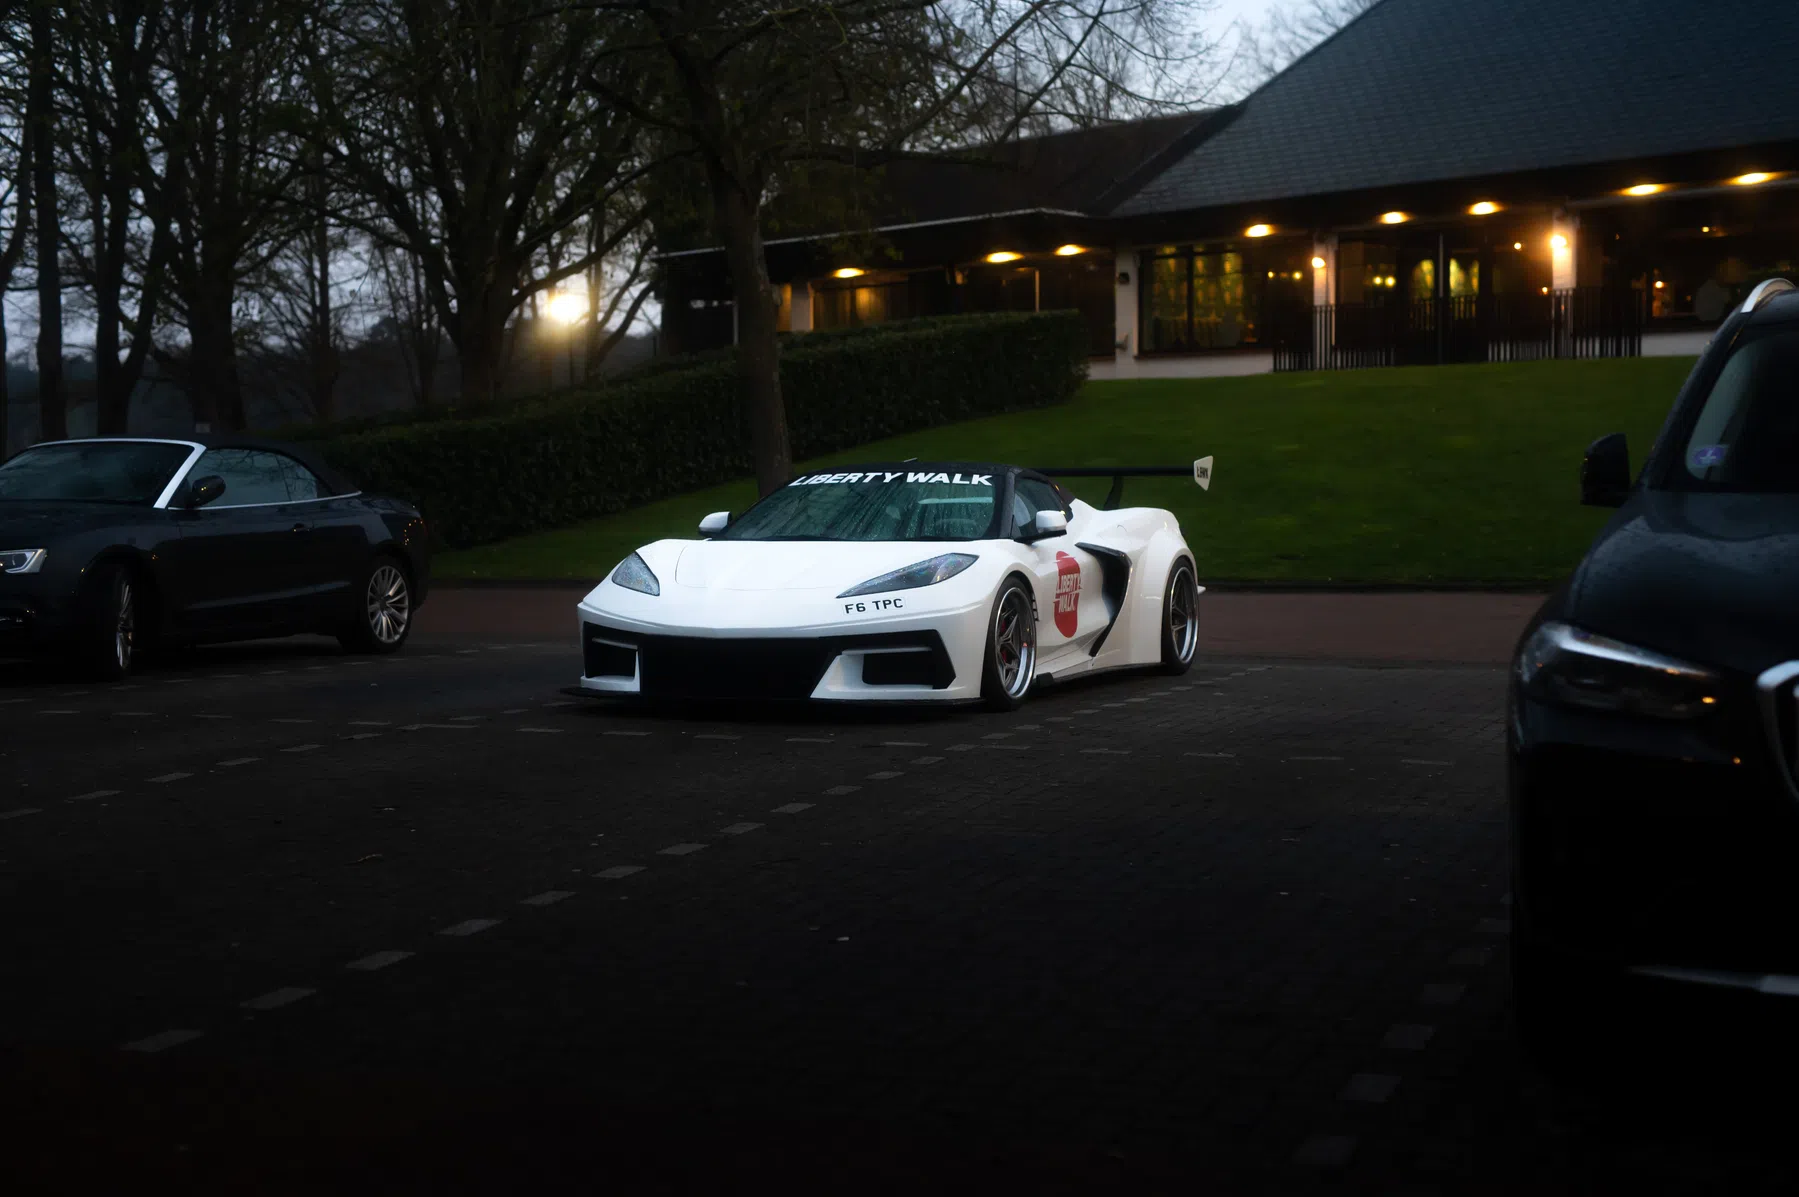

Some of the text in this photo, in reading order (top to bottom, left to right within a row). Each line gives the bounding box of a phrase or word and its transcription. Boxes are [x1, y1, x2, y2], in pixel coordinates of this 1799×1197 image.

[788, 472, 993, 487] LIBERTY WALK
[845, 598, 903, 614] F6 TPC
[1059, 593, 1076, 613] WALK
